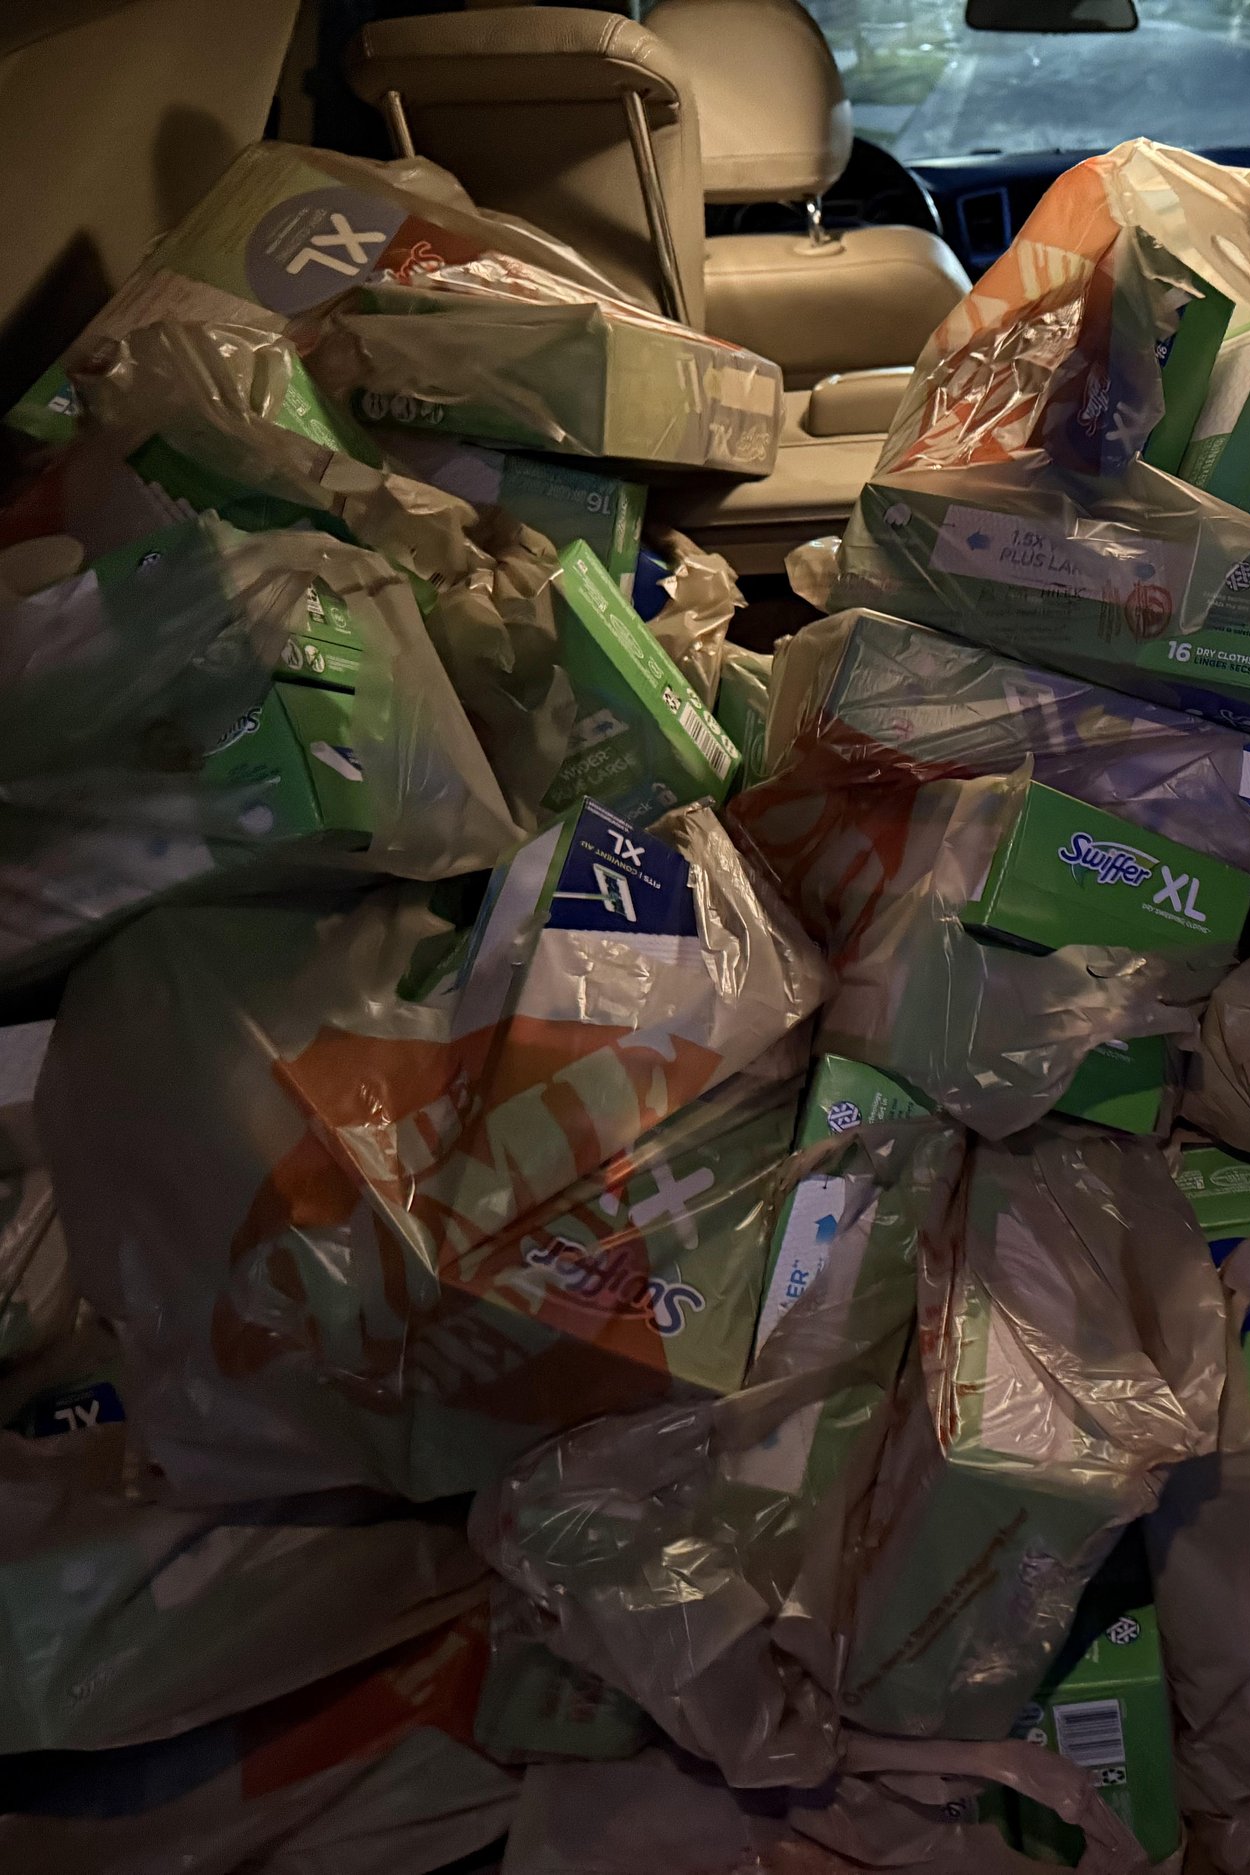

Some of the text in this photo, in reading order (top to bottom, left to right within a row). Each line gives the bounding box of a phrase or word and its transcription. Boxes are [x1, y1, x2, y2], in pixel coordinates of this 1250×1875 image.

[286, 213, 386, 276] XL
[587, 492, 610, 515] 16
[999, 549, 1045, 569] PLUS
[1168, 641, 1191, 662] 16
[1196, 646, 1217, 660] DRY
[607, 829, 645, 867] XL
[1058, 832, 1160, 887] Swiffer
[1153, 865, 1206, 922] XL
